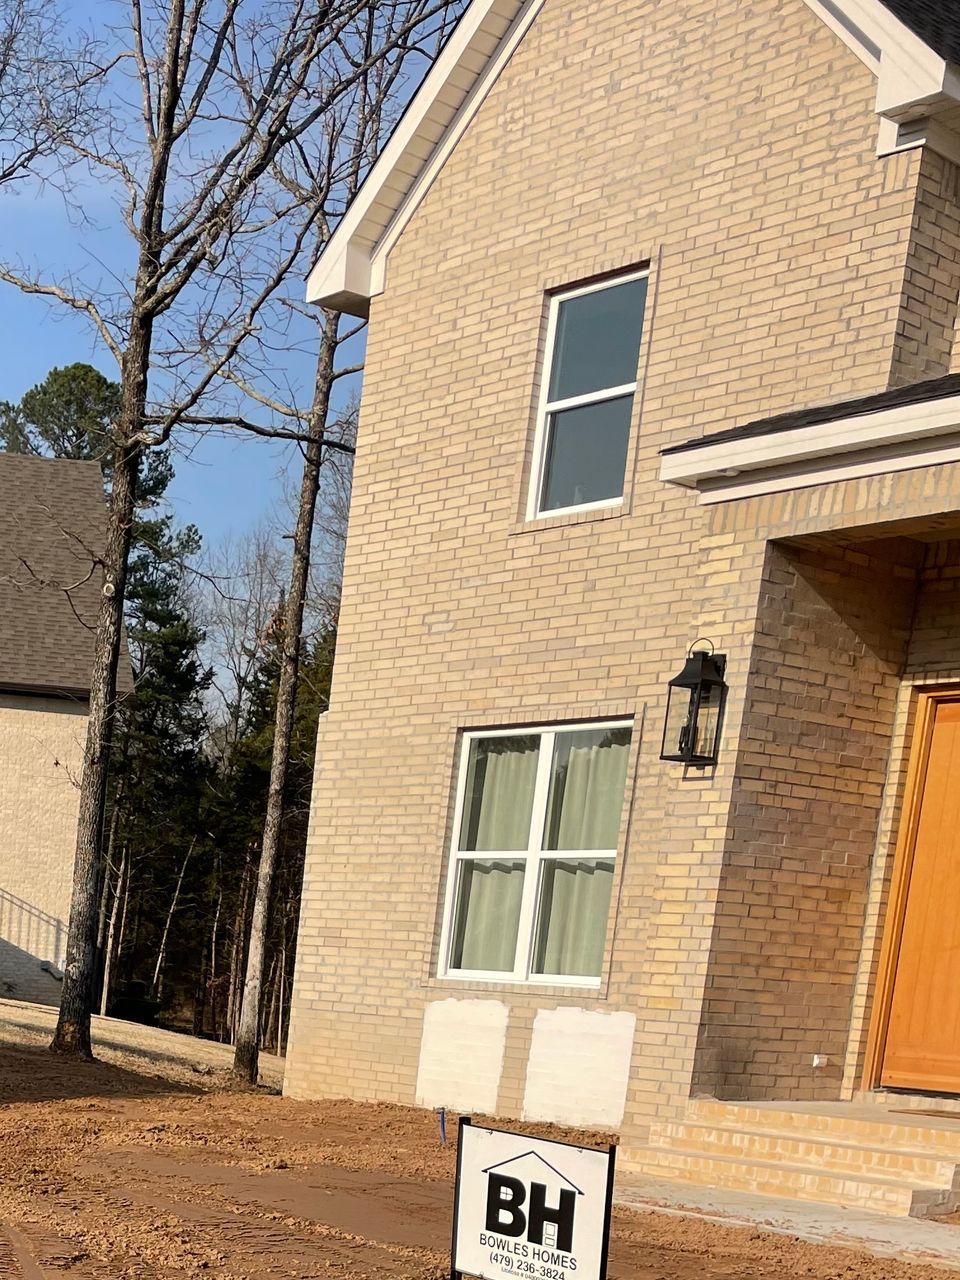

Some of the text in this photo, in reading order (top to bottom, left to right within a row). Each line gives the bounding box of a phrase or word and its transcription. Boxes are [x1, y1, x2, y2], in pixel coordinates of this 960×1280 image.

[485, 1171, 577, 1253] BH
[479, 1233, 578, 1271] BOWLES HOMES
[489, 1251, 514, 1269] (479)
